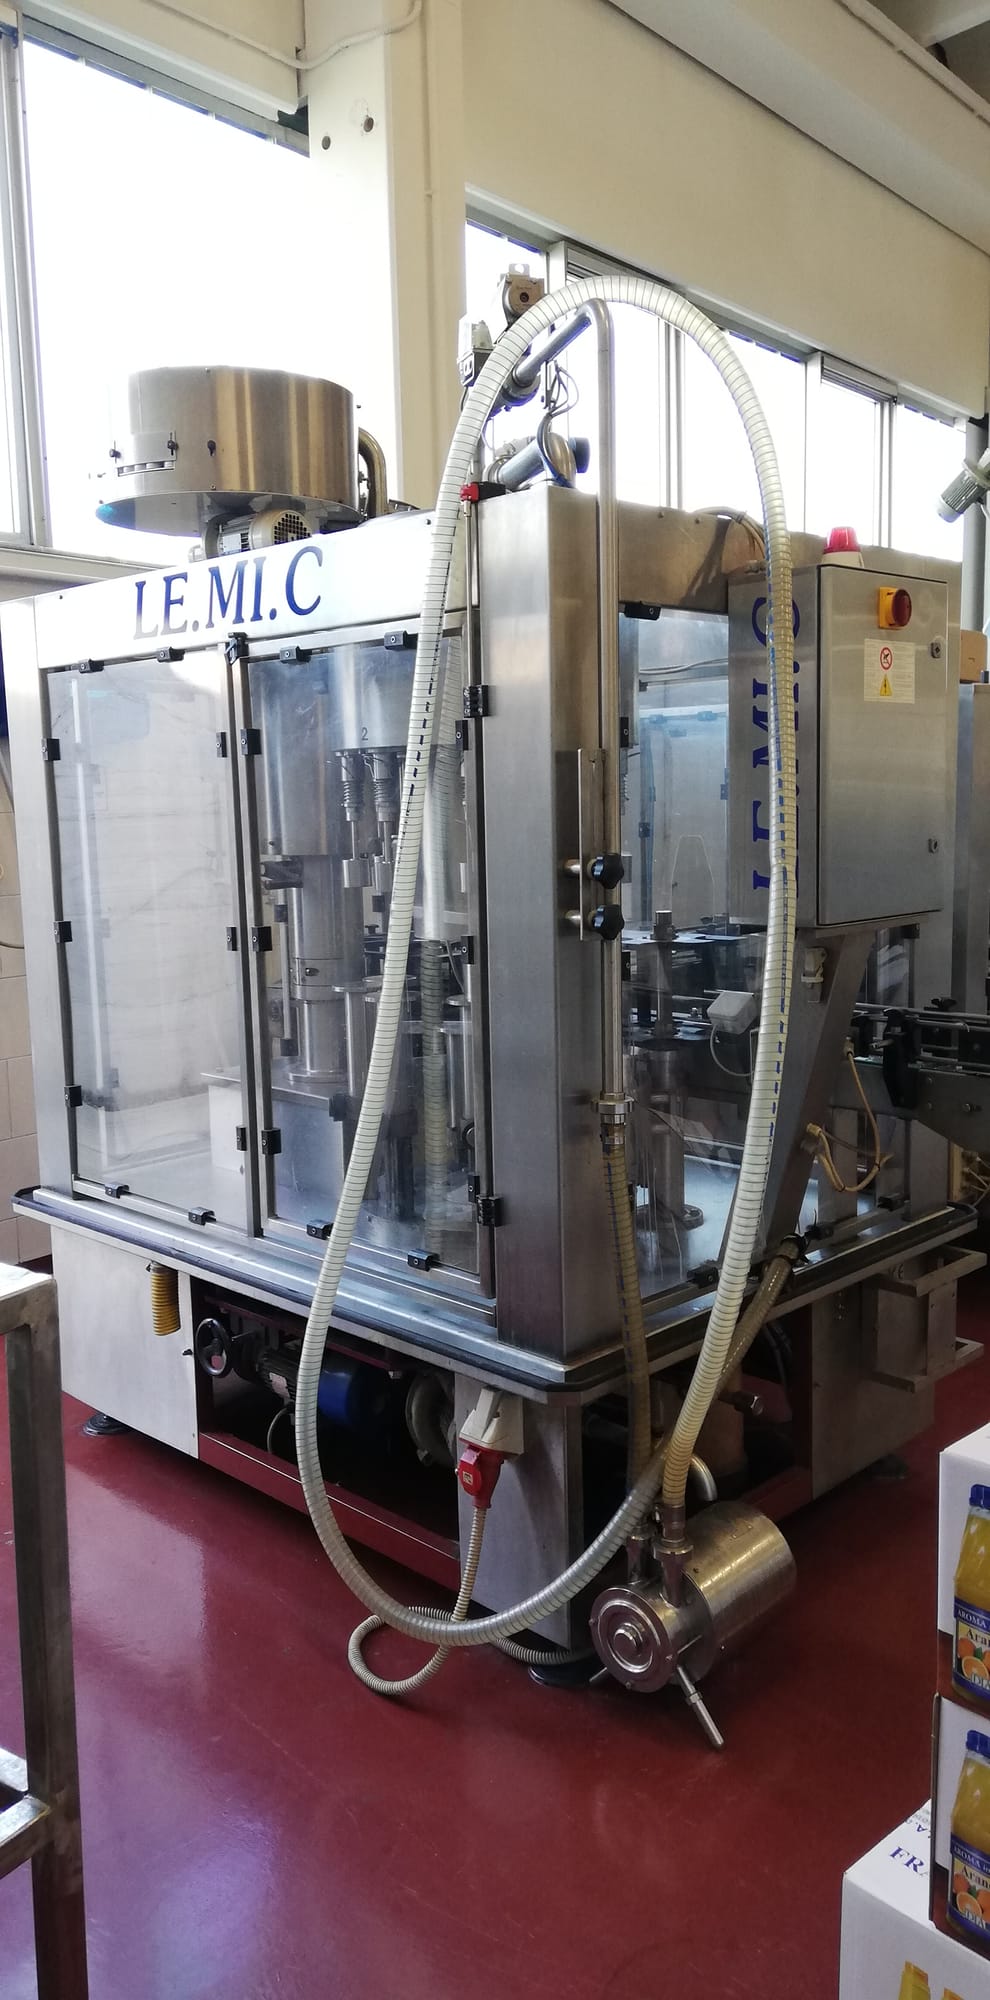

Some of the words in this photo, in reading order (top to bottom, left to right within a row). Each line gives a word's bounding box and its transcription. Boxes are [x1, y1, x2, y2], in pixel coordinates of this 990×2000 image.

[134, 546, 323, 640] LE.MI.C
[361, 727, 369, 741] 2
[957, 1608, 987, 1629] AROMA
[961, 1865, 990, 1889] Aran
